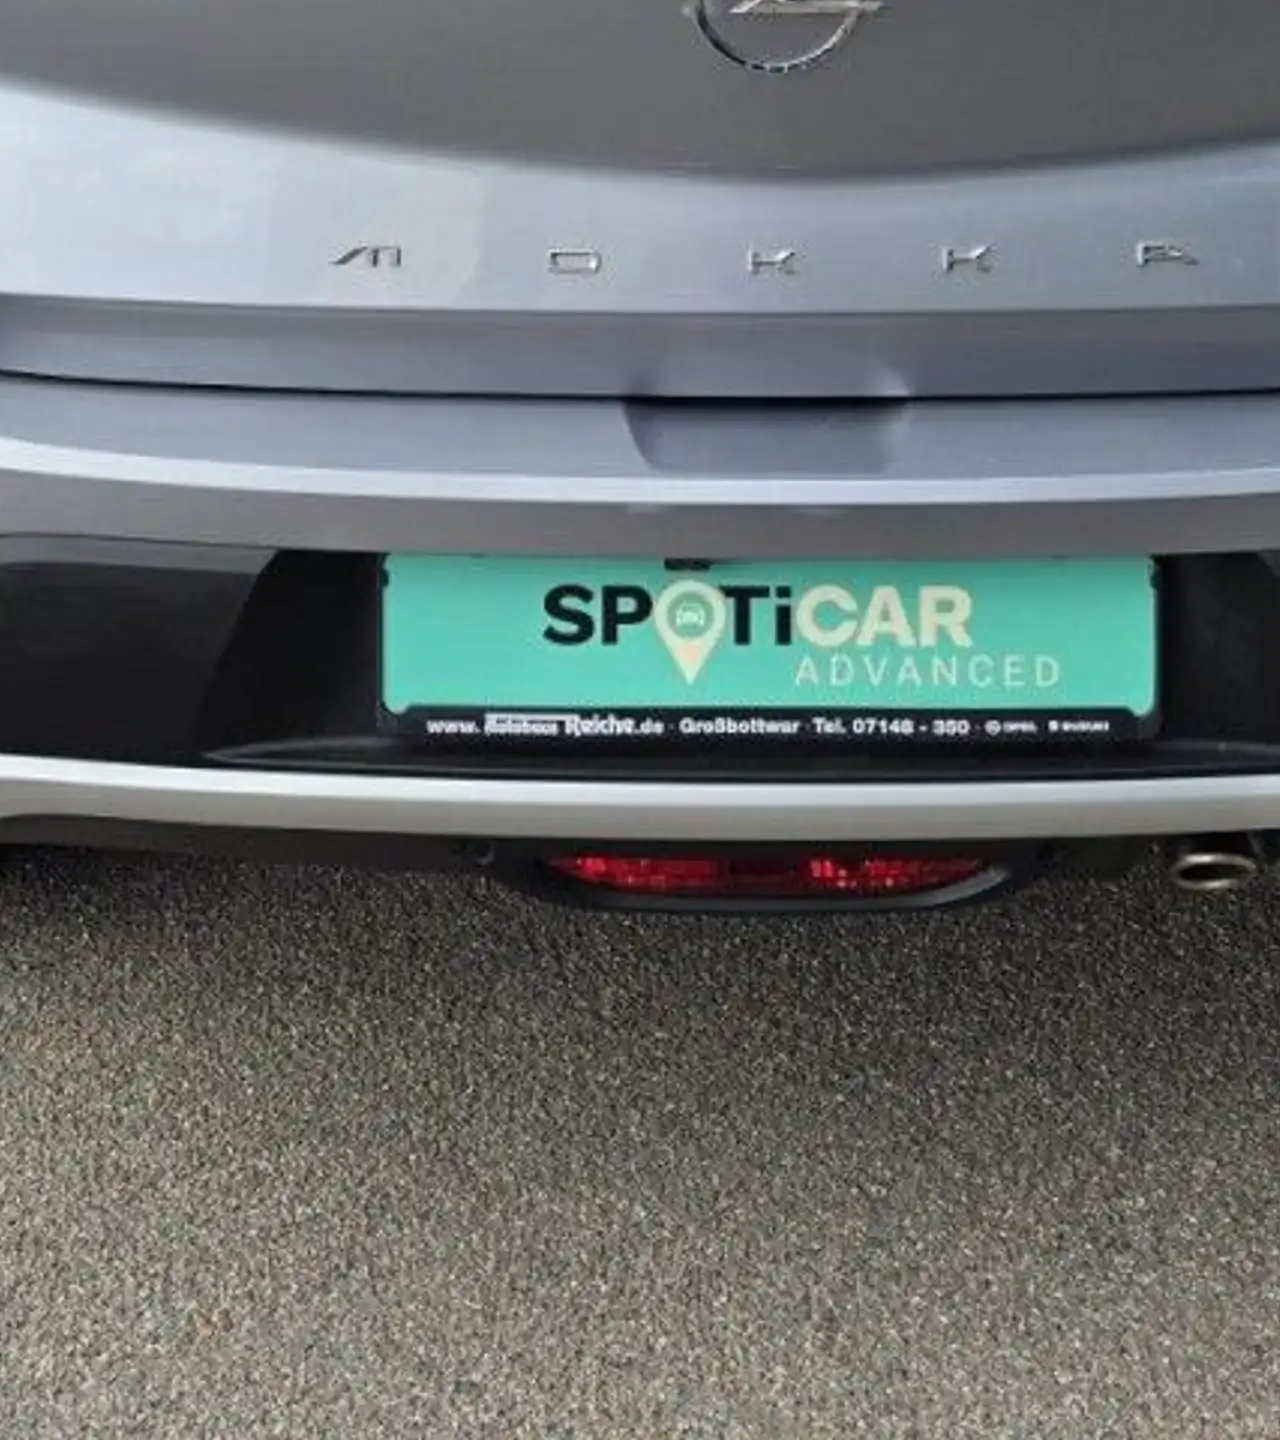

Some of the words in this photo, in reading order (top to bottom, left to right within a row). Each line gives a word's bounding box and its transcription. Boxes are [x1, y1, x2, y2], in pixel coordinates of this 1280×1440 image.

[330, 242, 1202, 275] MOKKA
[794, 654, 1061, 688] ADVANCED
[678, 717, 802, 735] Großbottwar
[812, 717, 847, 734] Tel.
